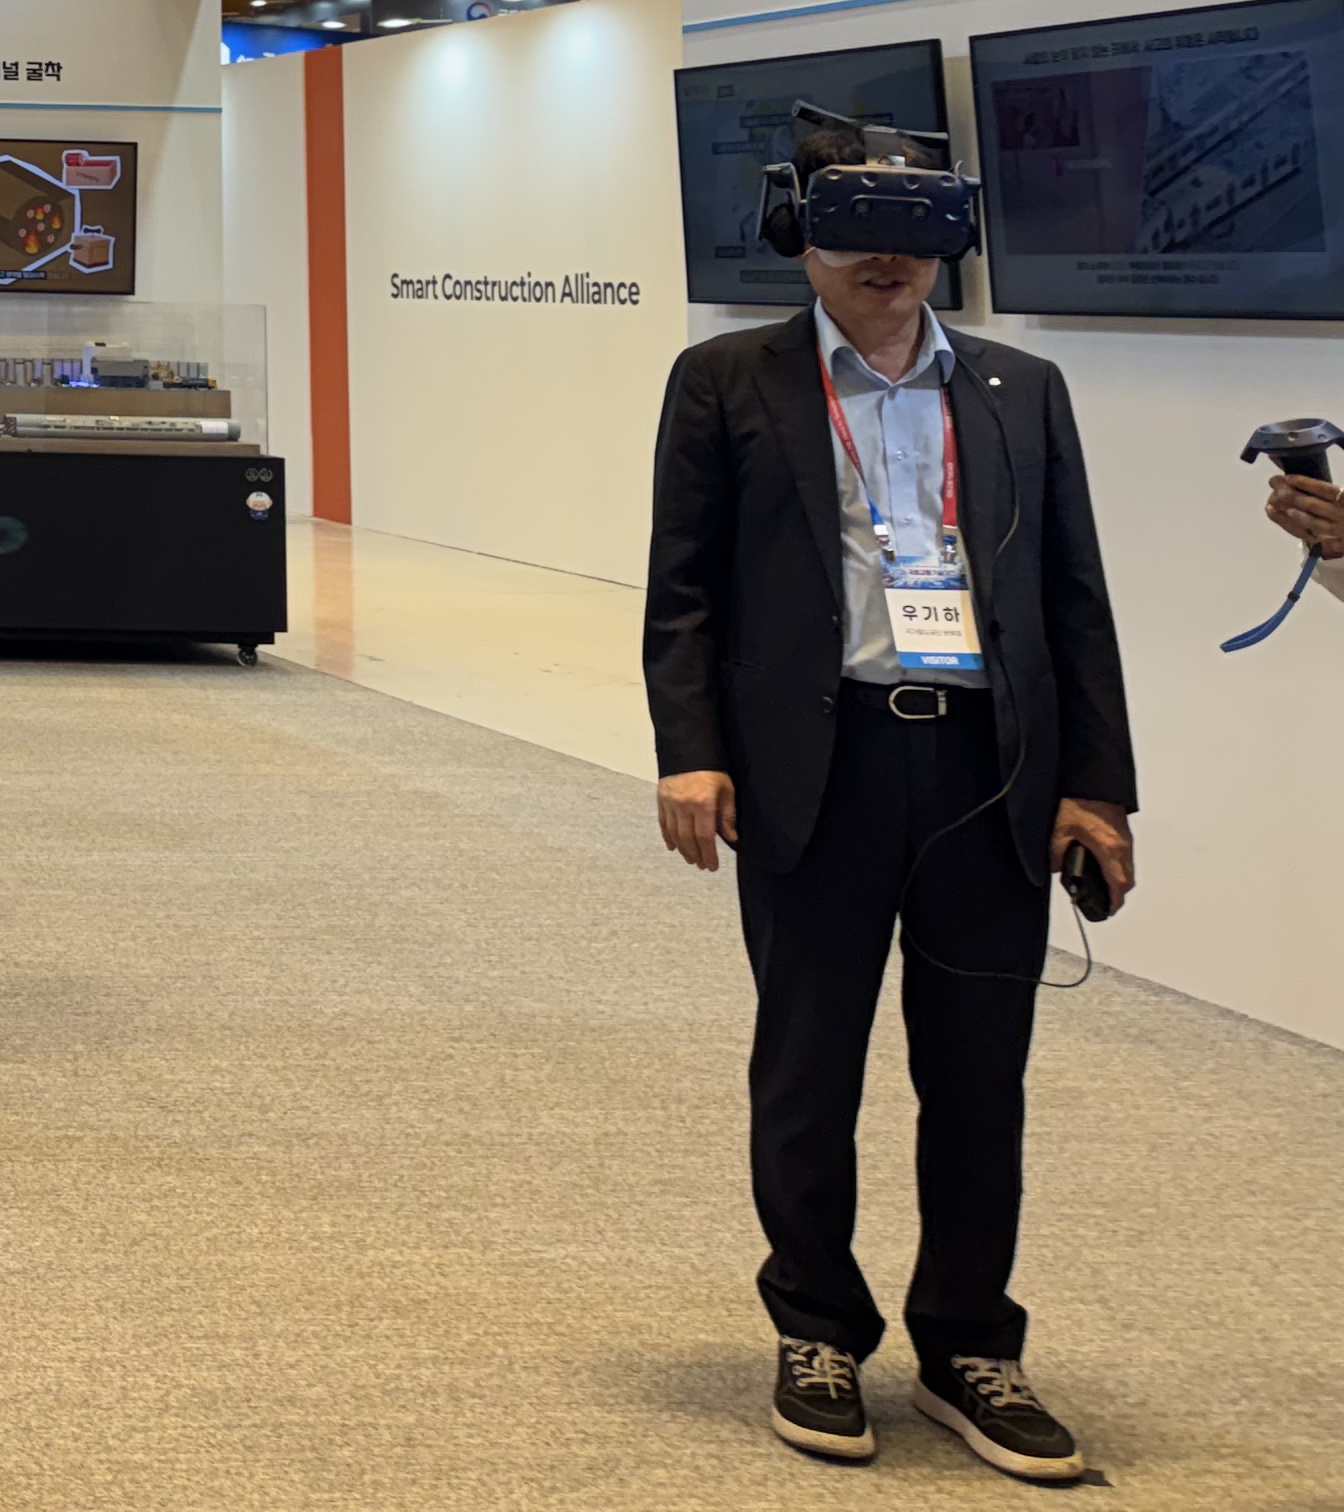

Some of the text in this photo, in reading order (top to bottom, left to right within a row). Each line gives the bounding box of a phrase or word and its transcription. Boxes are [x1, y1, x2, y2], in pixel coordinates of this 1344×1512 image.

[26, 61, 63, 82] 굴착
[390, 271, 641, 306] Smart Construction Alliance
[902, 604, 960, 623] 우기하
